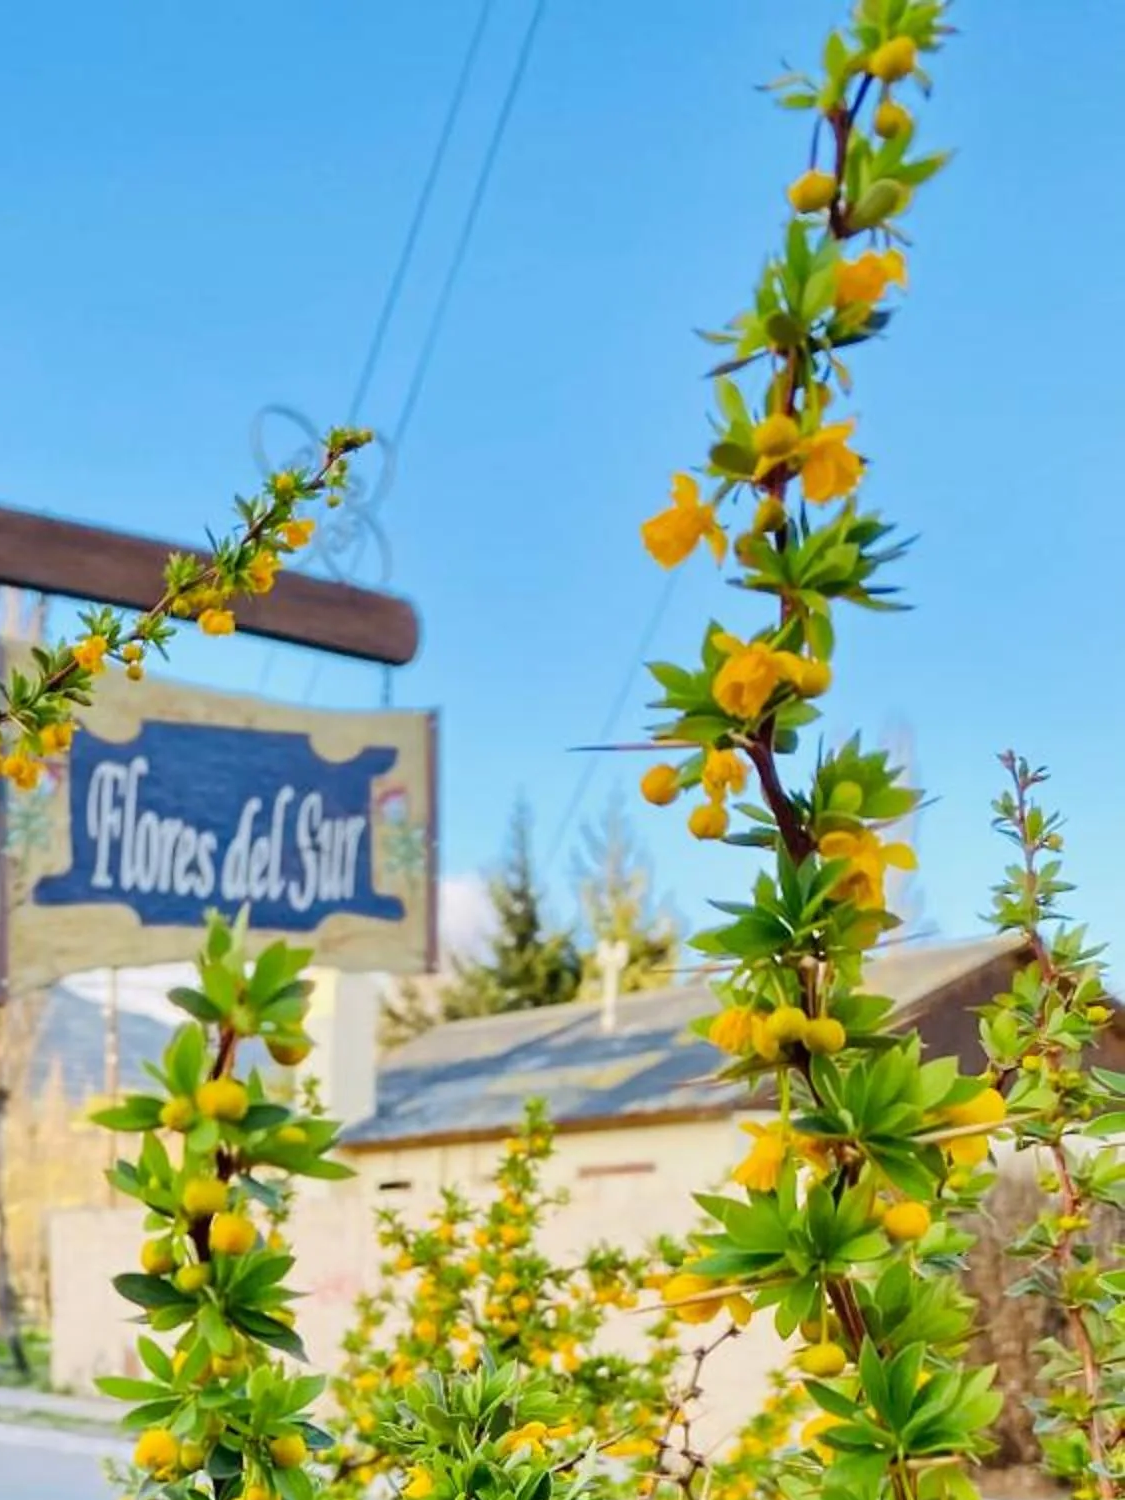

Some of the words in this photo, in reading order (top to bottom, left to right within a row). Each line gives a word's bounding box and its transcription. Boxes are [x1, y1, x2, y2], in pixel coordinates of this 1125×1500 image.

[87, 756, 217, 899] Flores
[221, 785, 295, 901] del
[288, 792, 366, 911] Sur
